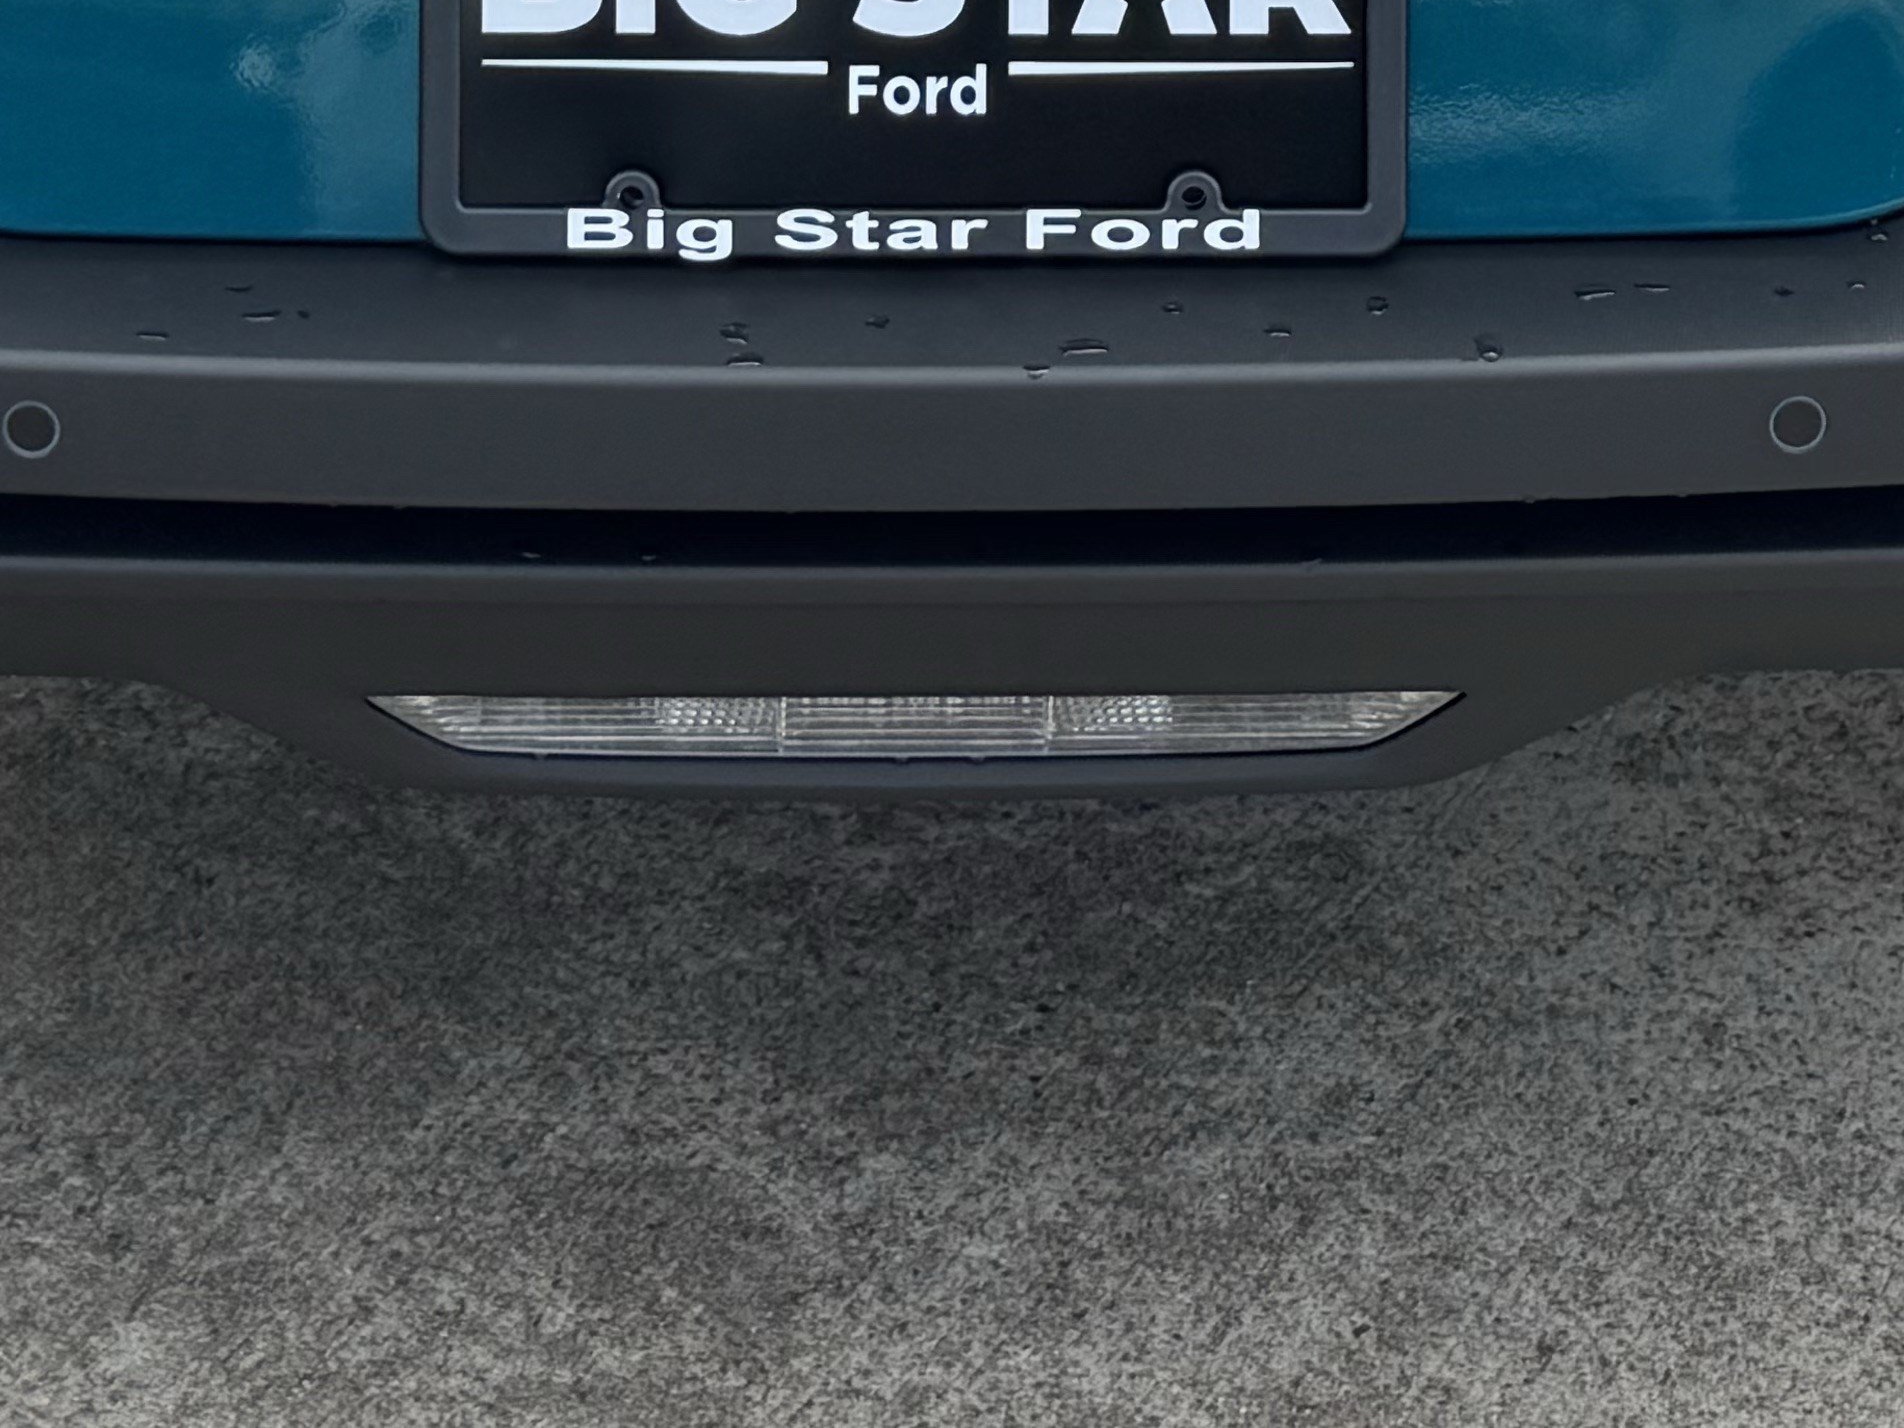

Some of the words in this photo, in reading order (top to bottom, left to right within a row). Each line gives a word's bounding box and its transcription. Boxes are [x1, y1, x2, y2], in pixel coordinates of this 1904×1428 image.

[847, 62, 988, 116] Ford
[565, 206, 734, 263] Big
[773, 206, 990, 252] Star
[1024, 206, 1262, 252] Ford
